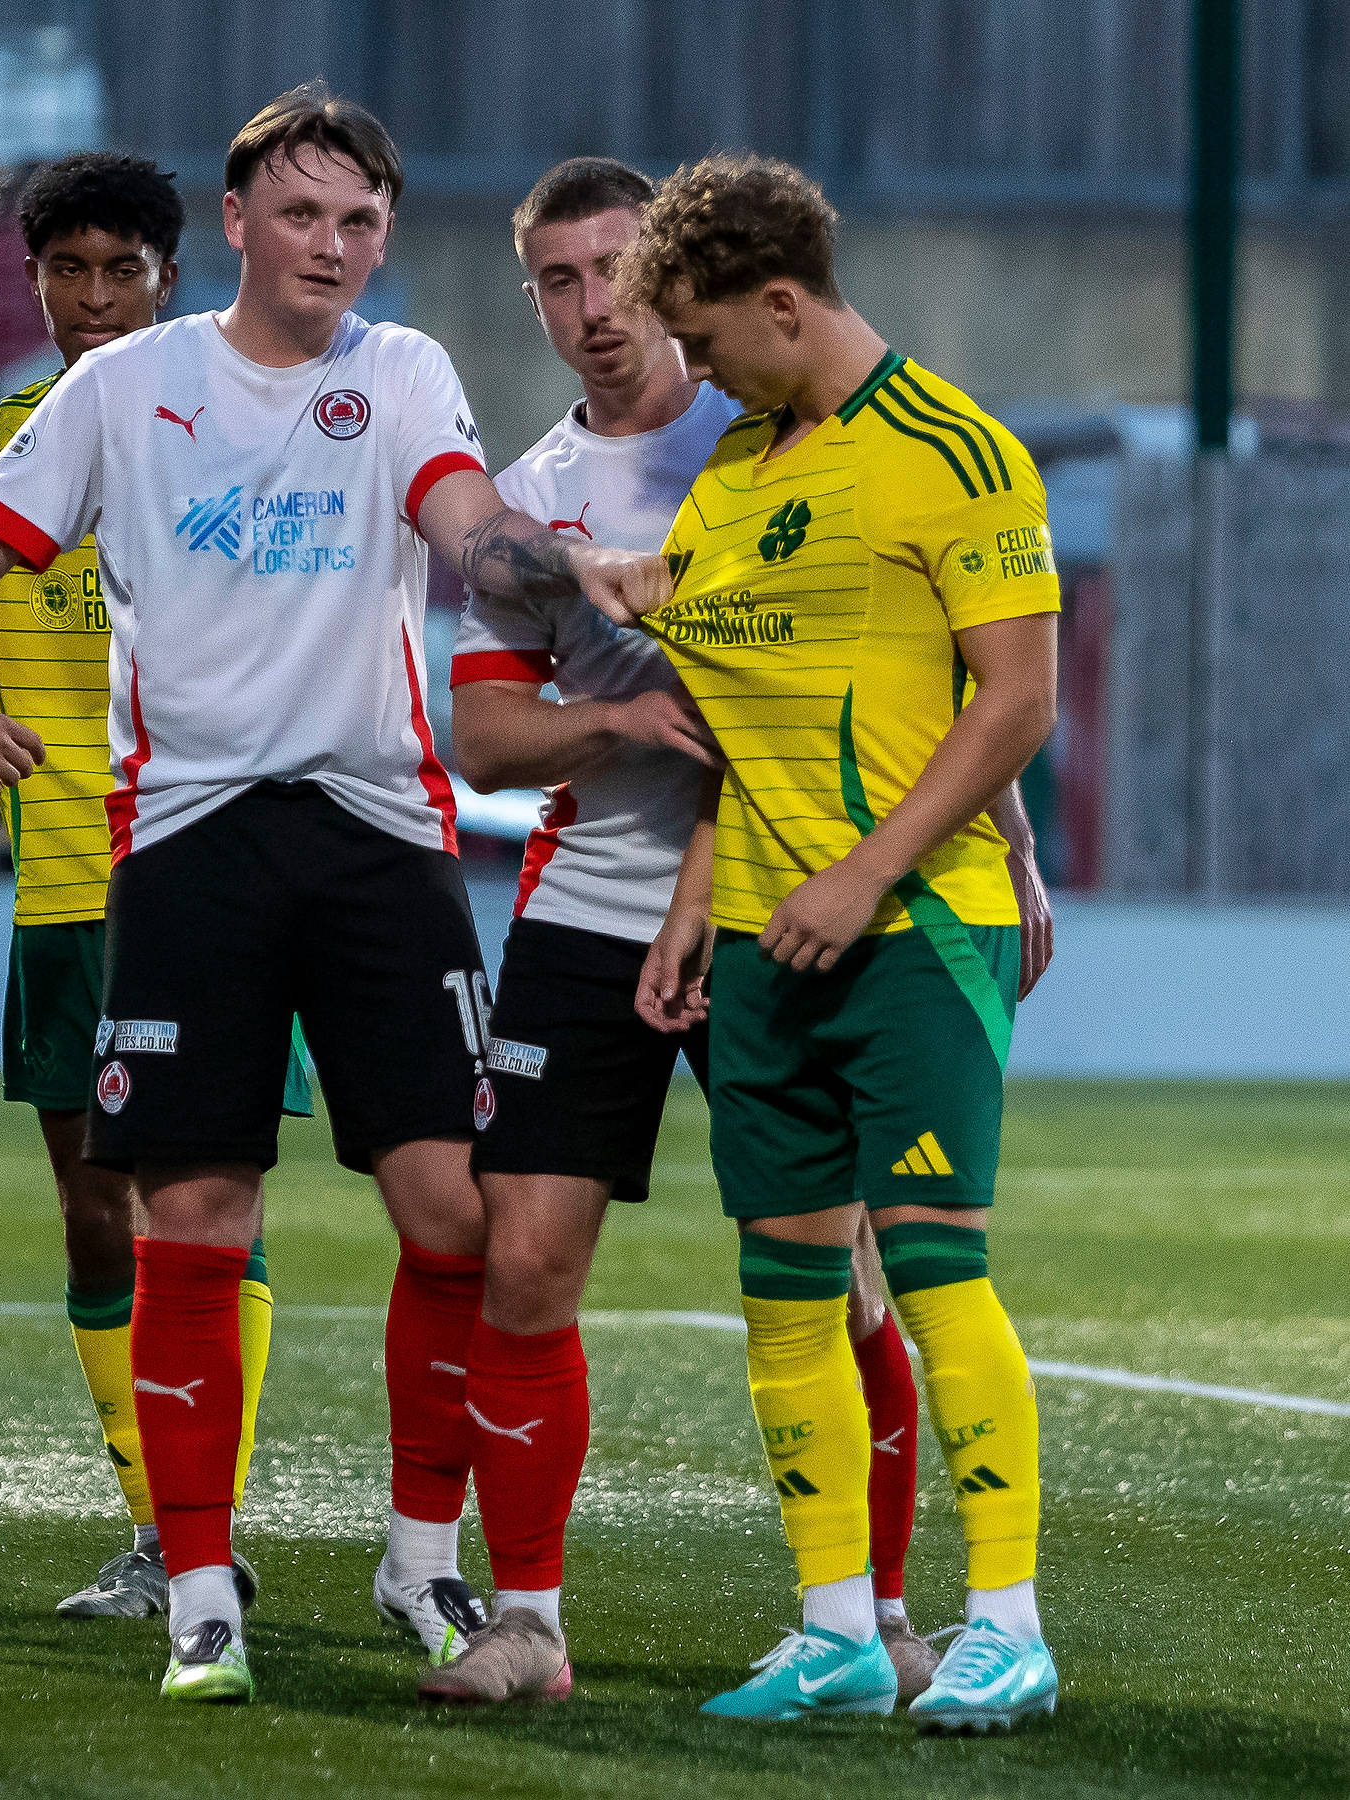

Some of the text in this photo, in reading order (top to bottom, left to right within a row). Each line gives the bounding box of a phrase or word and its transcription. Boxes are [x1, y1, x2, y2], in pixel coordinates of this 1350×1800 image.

[253, 489, 344, 520] CAMERON
[253, 519, 317, 545] EVENT
[995, 526, 1042, 554] CELTIC
[253, 545, 356, 575] LOGISTICS
[663, 611, 795, 645] FOUNDATION
